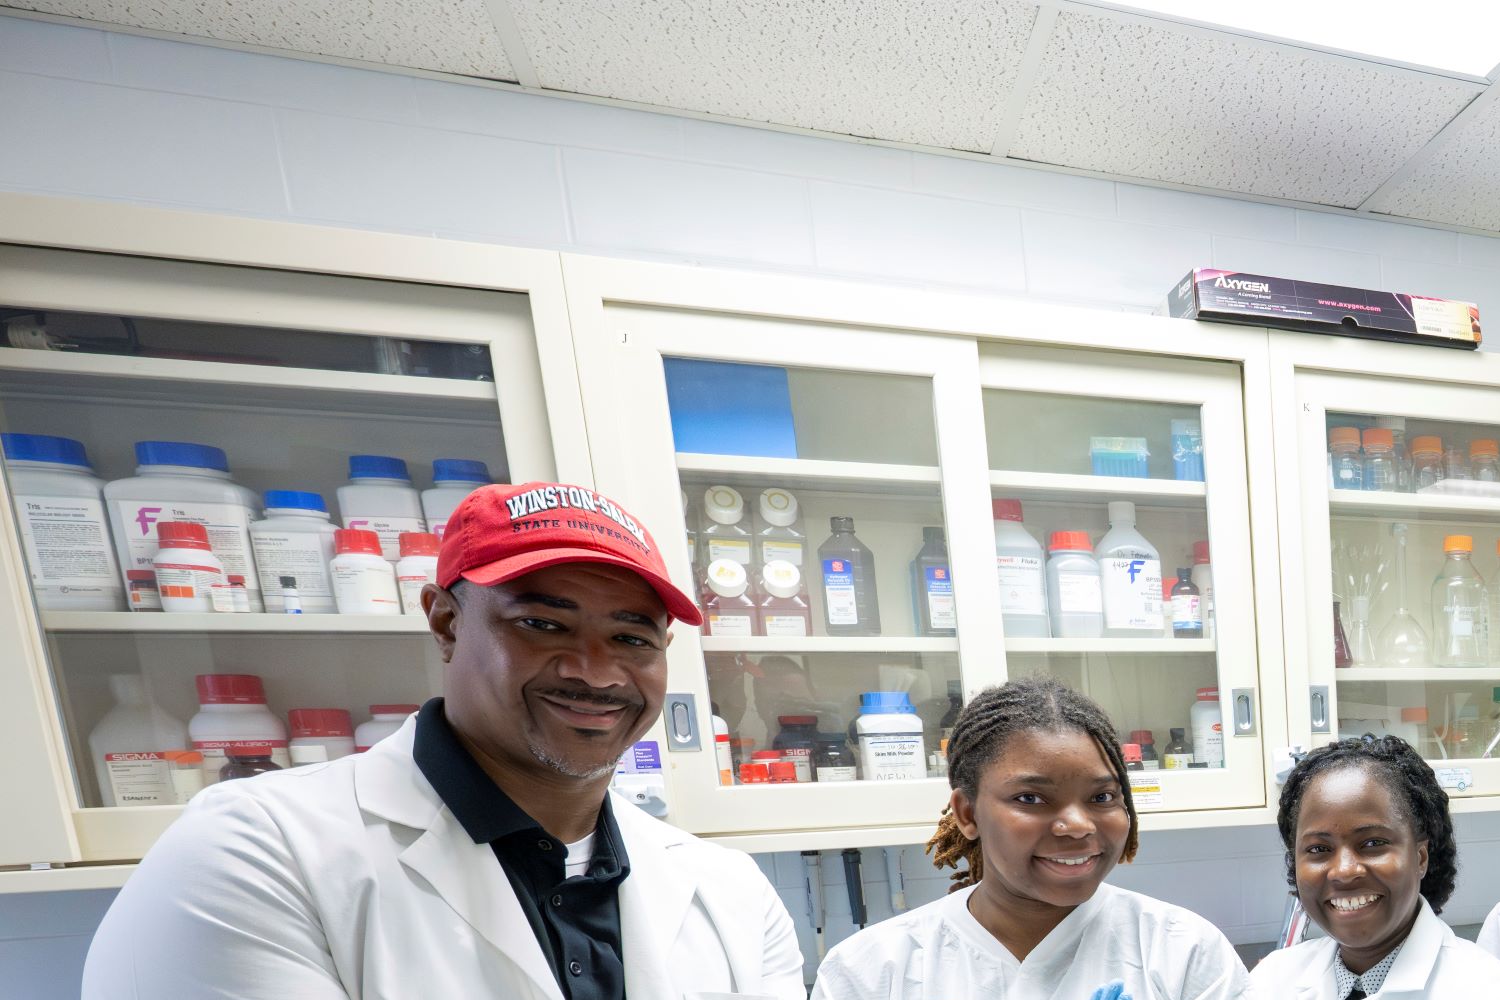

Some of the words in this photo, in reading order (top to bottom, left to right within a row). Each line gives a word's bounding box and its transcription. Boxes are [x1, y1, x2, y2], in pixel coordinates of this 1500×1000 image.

[1318, 299, 1381, 312] www.axygen.com
[512, 519, 560, 533] STATE
[567, 520, 650, 555] UNIVERSITY
[112, 753, 159, 761] SIGMA
[786, 748, 812, 756] SIG
